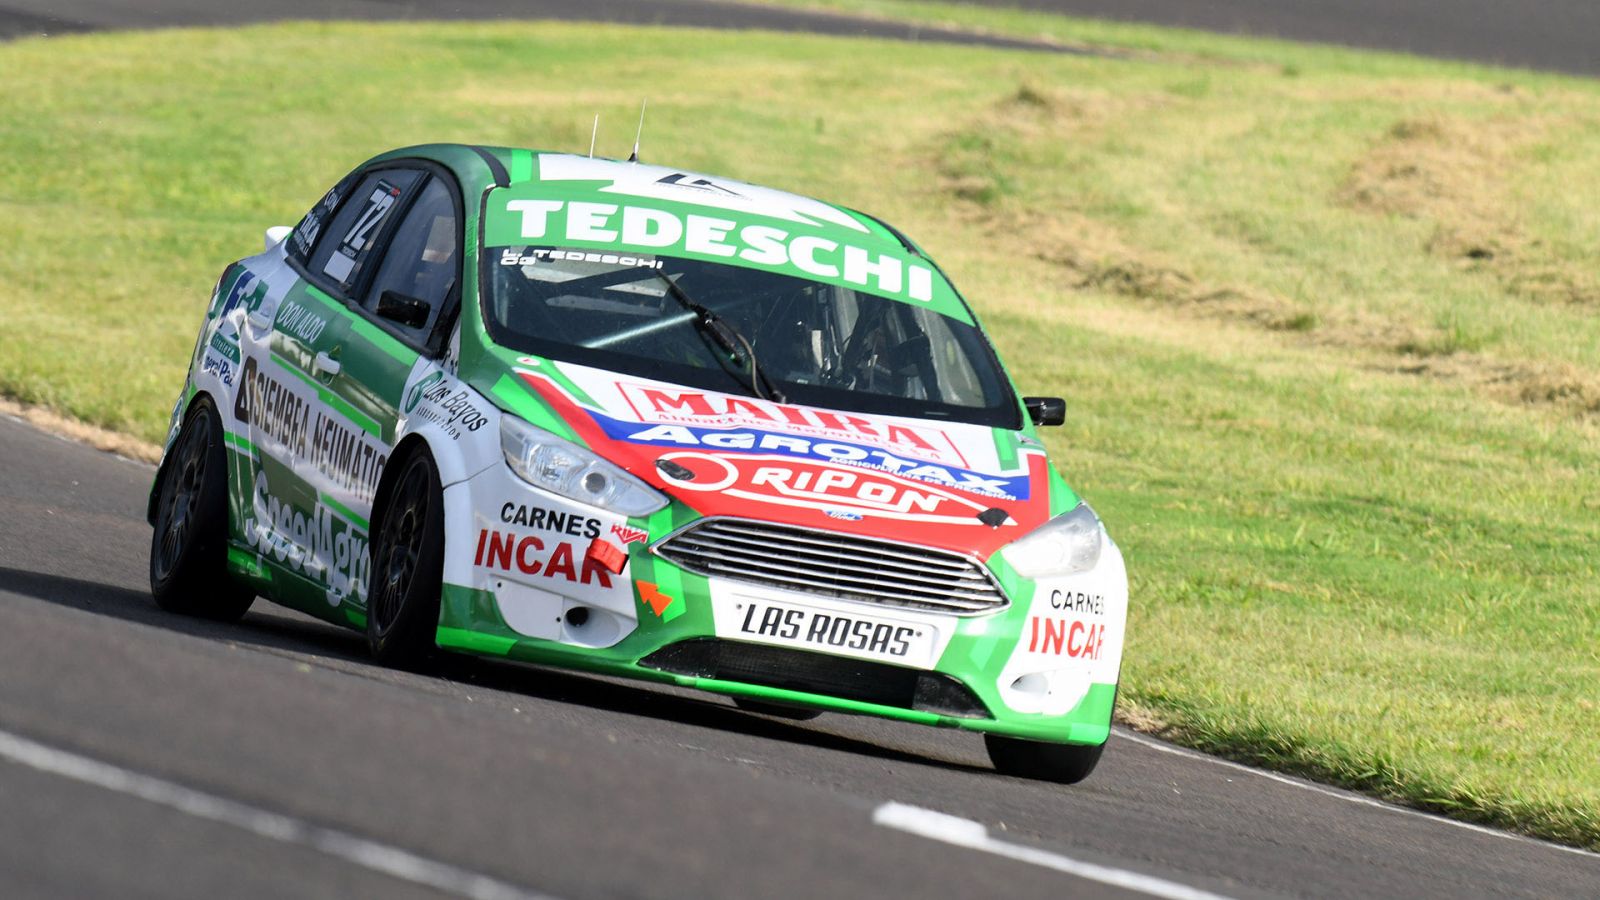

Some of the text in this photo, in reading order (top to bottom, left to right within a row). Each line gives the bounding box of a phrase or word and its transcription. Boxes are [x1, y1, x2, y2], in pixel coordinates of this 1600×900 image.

[342, 188, 395, 251] 72
[506, 199, 933, 302] TEDESCHI
[533, 249, 665, 271] TEDESCHI
[254, 371, 310, 460] SIEMBRA
[423, 379, 452, 404] Los
[440, 390, 489, 432] Bayos
[642, 388, 939, 451] MAIRA
[628, 424, 1012, 495] AGROTAX
[751, 467, 950, 513] RIPON
[245, 469, 371, 608] SpeedAgro
[501, 501, 602, 540] CARNES
[741, 604, 915, 657] LAS ROSAS
